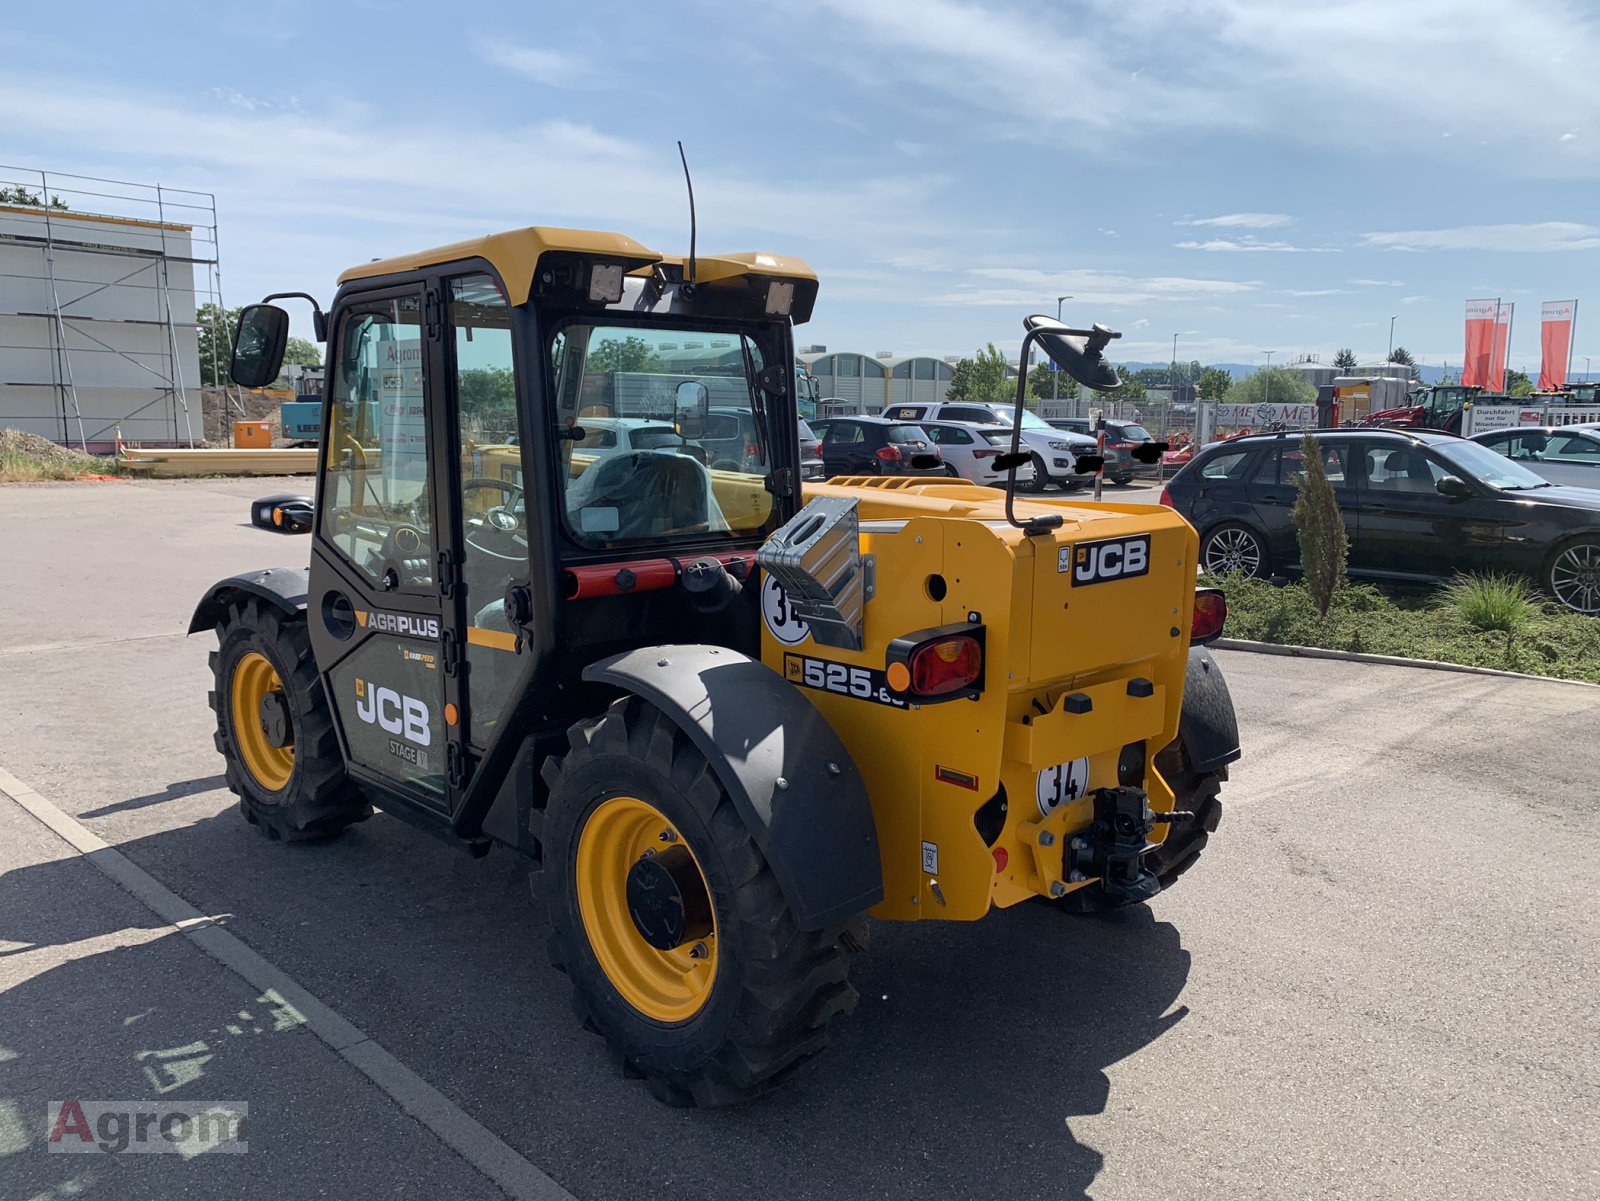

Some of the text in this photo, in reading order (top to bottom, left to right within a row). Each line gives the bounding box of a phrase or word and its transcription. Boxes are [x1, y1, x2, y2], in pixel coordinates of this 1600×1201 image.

[1076, 540, 1147, 581] JCB
[356, 682, 431, 747] JCB
[389, 740, 417, 763] STAGE
[1047, 761, 1078, 808] 34
